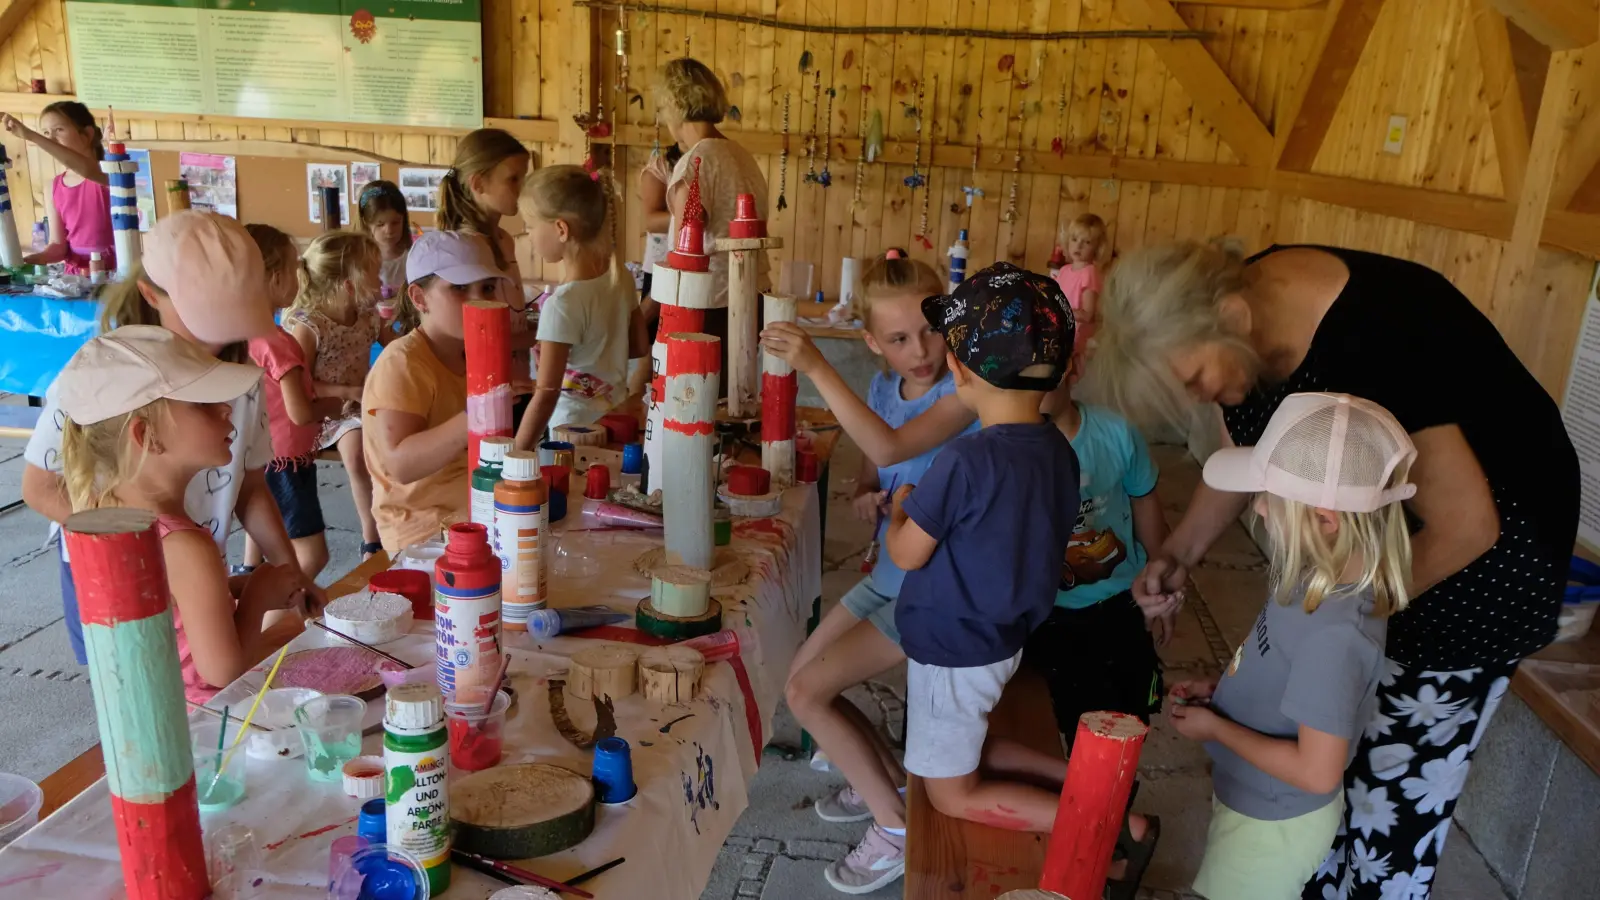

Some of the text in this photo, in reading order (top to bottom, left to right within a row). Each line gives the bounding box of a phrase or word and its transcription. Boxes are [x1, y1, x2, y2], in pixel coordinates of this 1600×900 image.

[407, 757, 445, 772] AMINGO
[411, 770, 447, 787] LLTON-
[415, 789, 439, 802] UND
